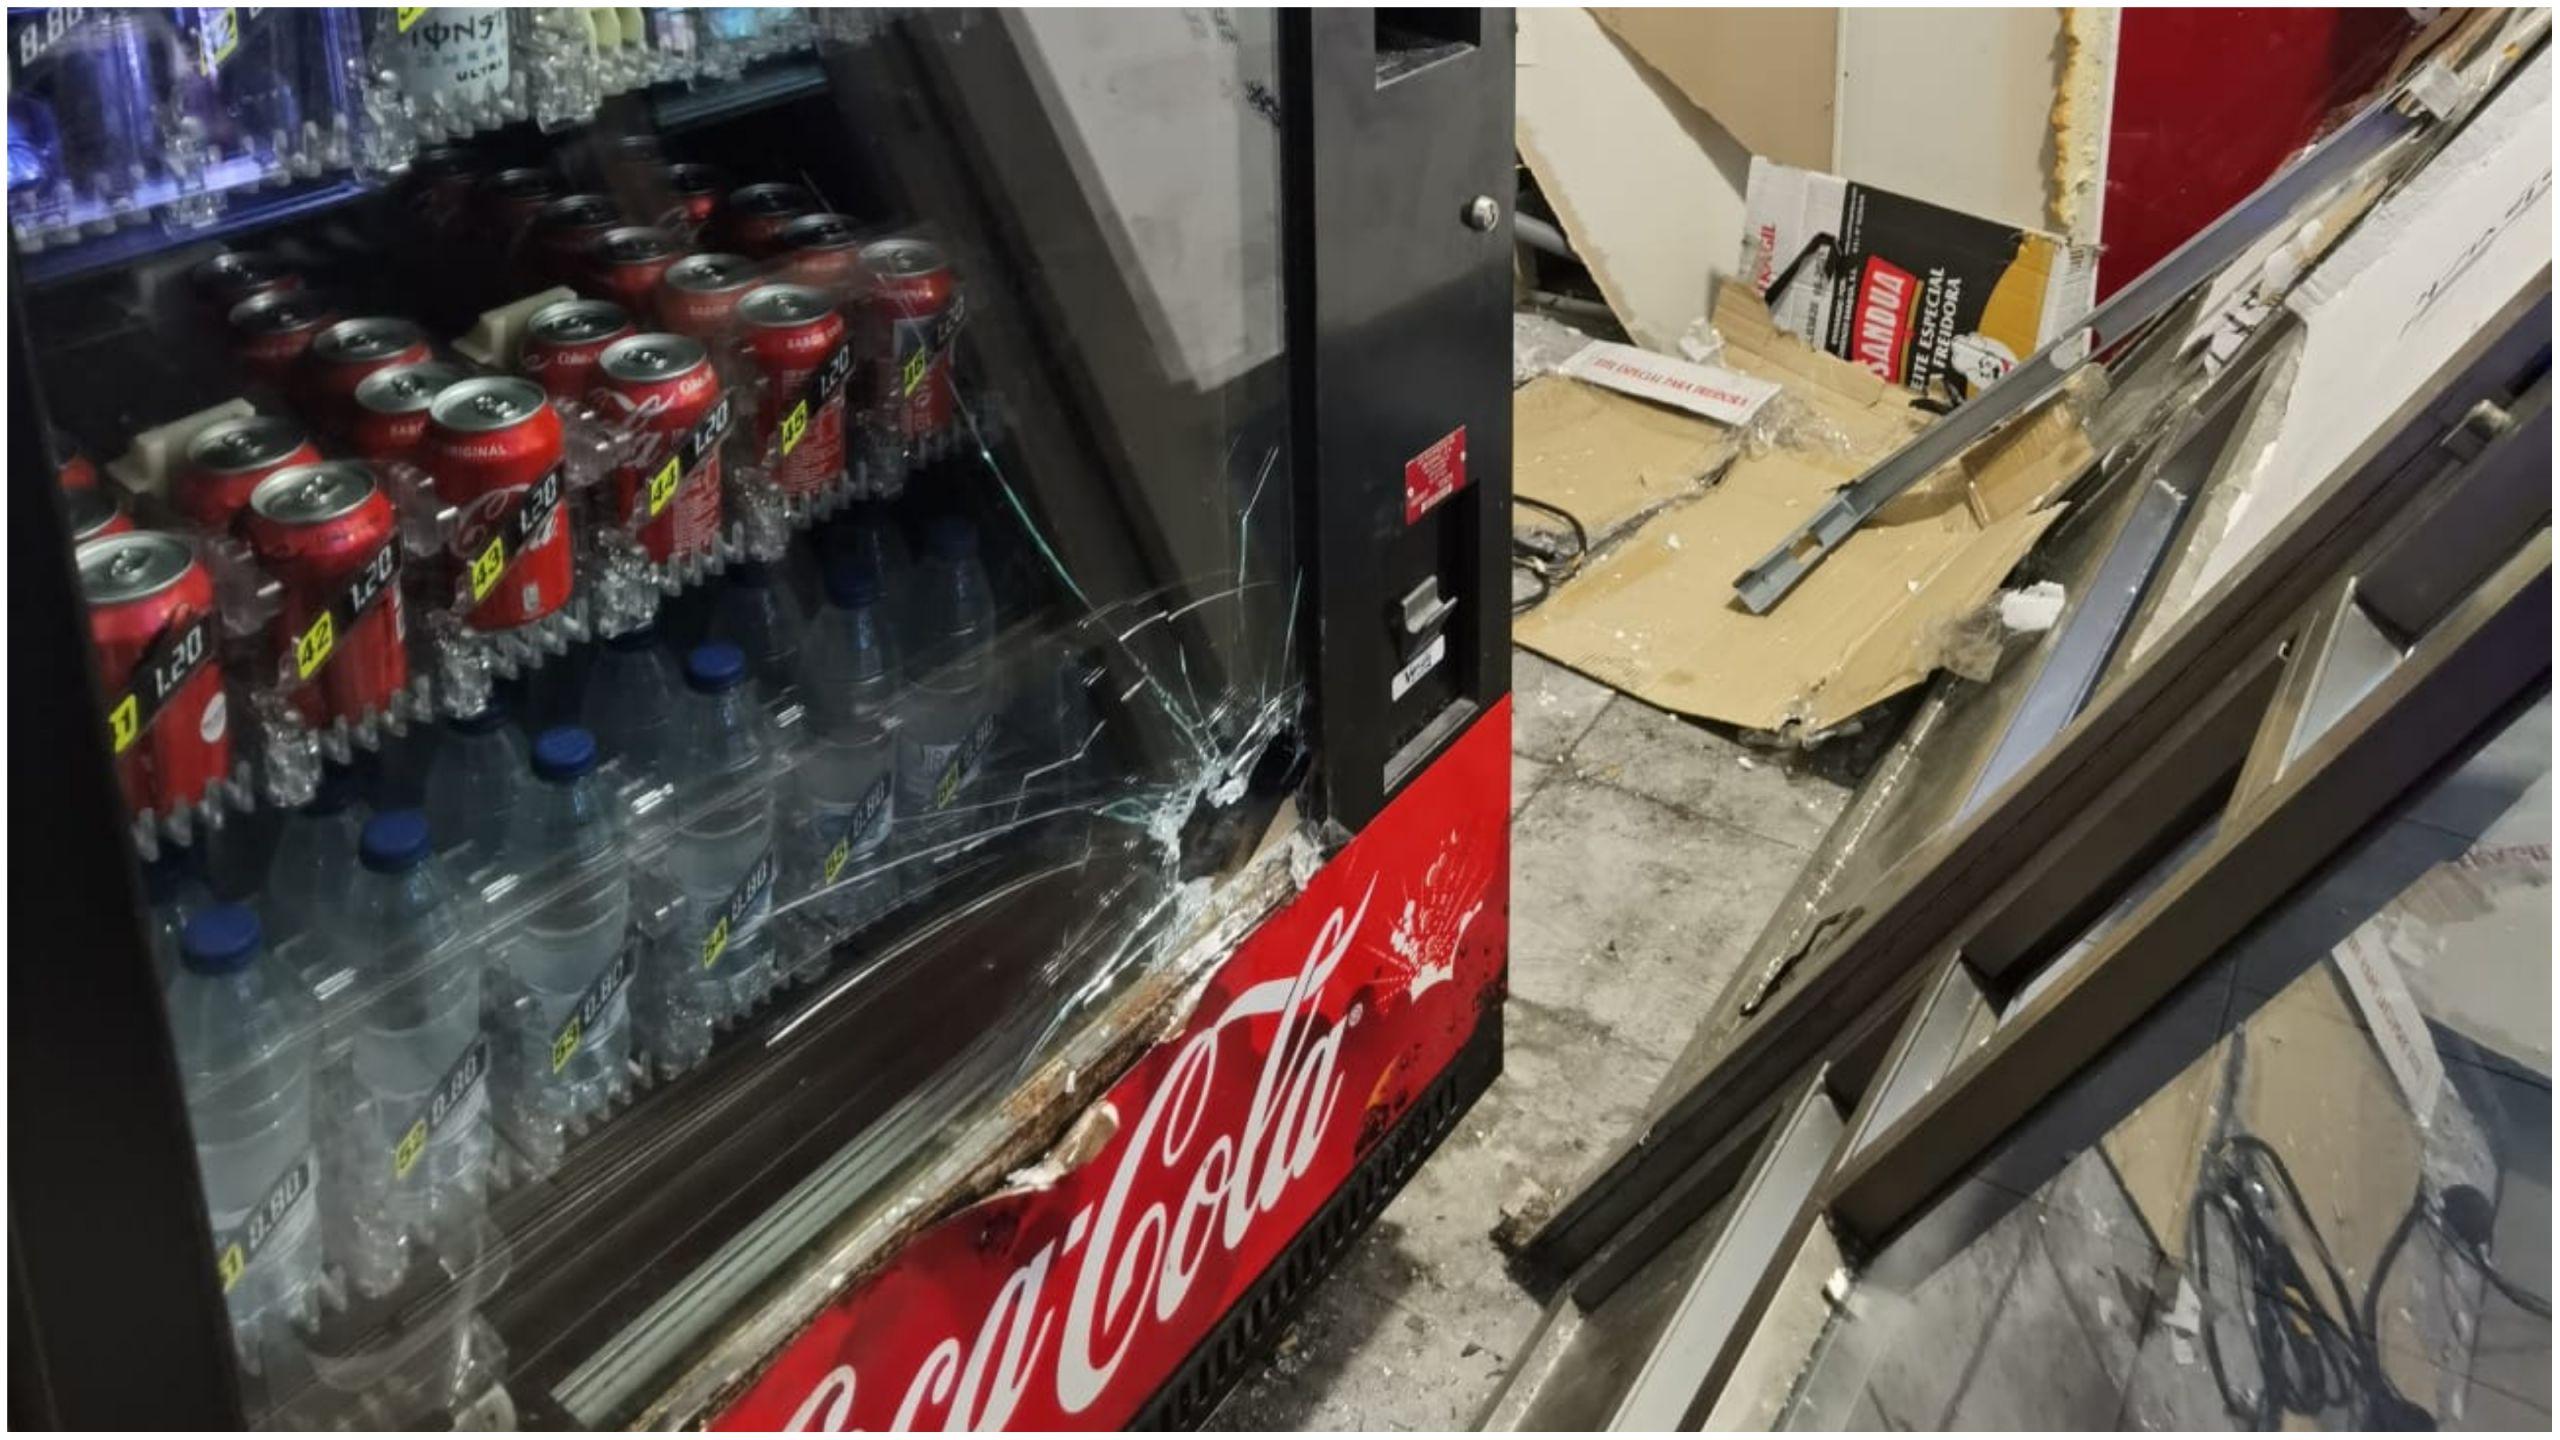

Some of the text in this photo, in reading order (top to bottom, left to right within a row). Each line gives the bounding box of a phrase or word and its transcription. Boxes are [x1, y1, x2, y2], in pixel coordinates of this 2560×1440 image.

[1861, 270, 1906, 377] SANDUA
[1920, 266, 1945, 350] ESPECIAL
[1932, 277, 1963, 370] FREIDORA
[820, 343, 849, 397] 1.20
[694, 399, 728, 456] 1.20
[520, 472, 557, 535] 1.20
[652, 461, 677, 501] 44
[350, 545, 393, 612] 1.20
[475, 546, 501, 586] 43
[154, 624, 203, 698] 1.20
[301, 618, 331, 669] 42
[431, 1054, 477, 1127] 0.80
[782, 870, 1379, 1432] ca-Cola
[248, 1169, 300, 1249] 0.80
